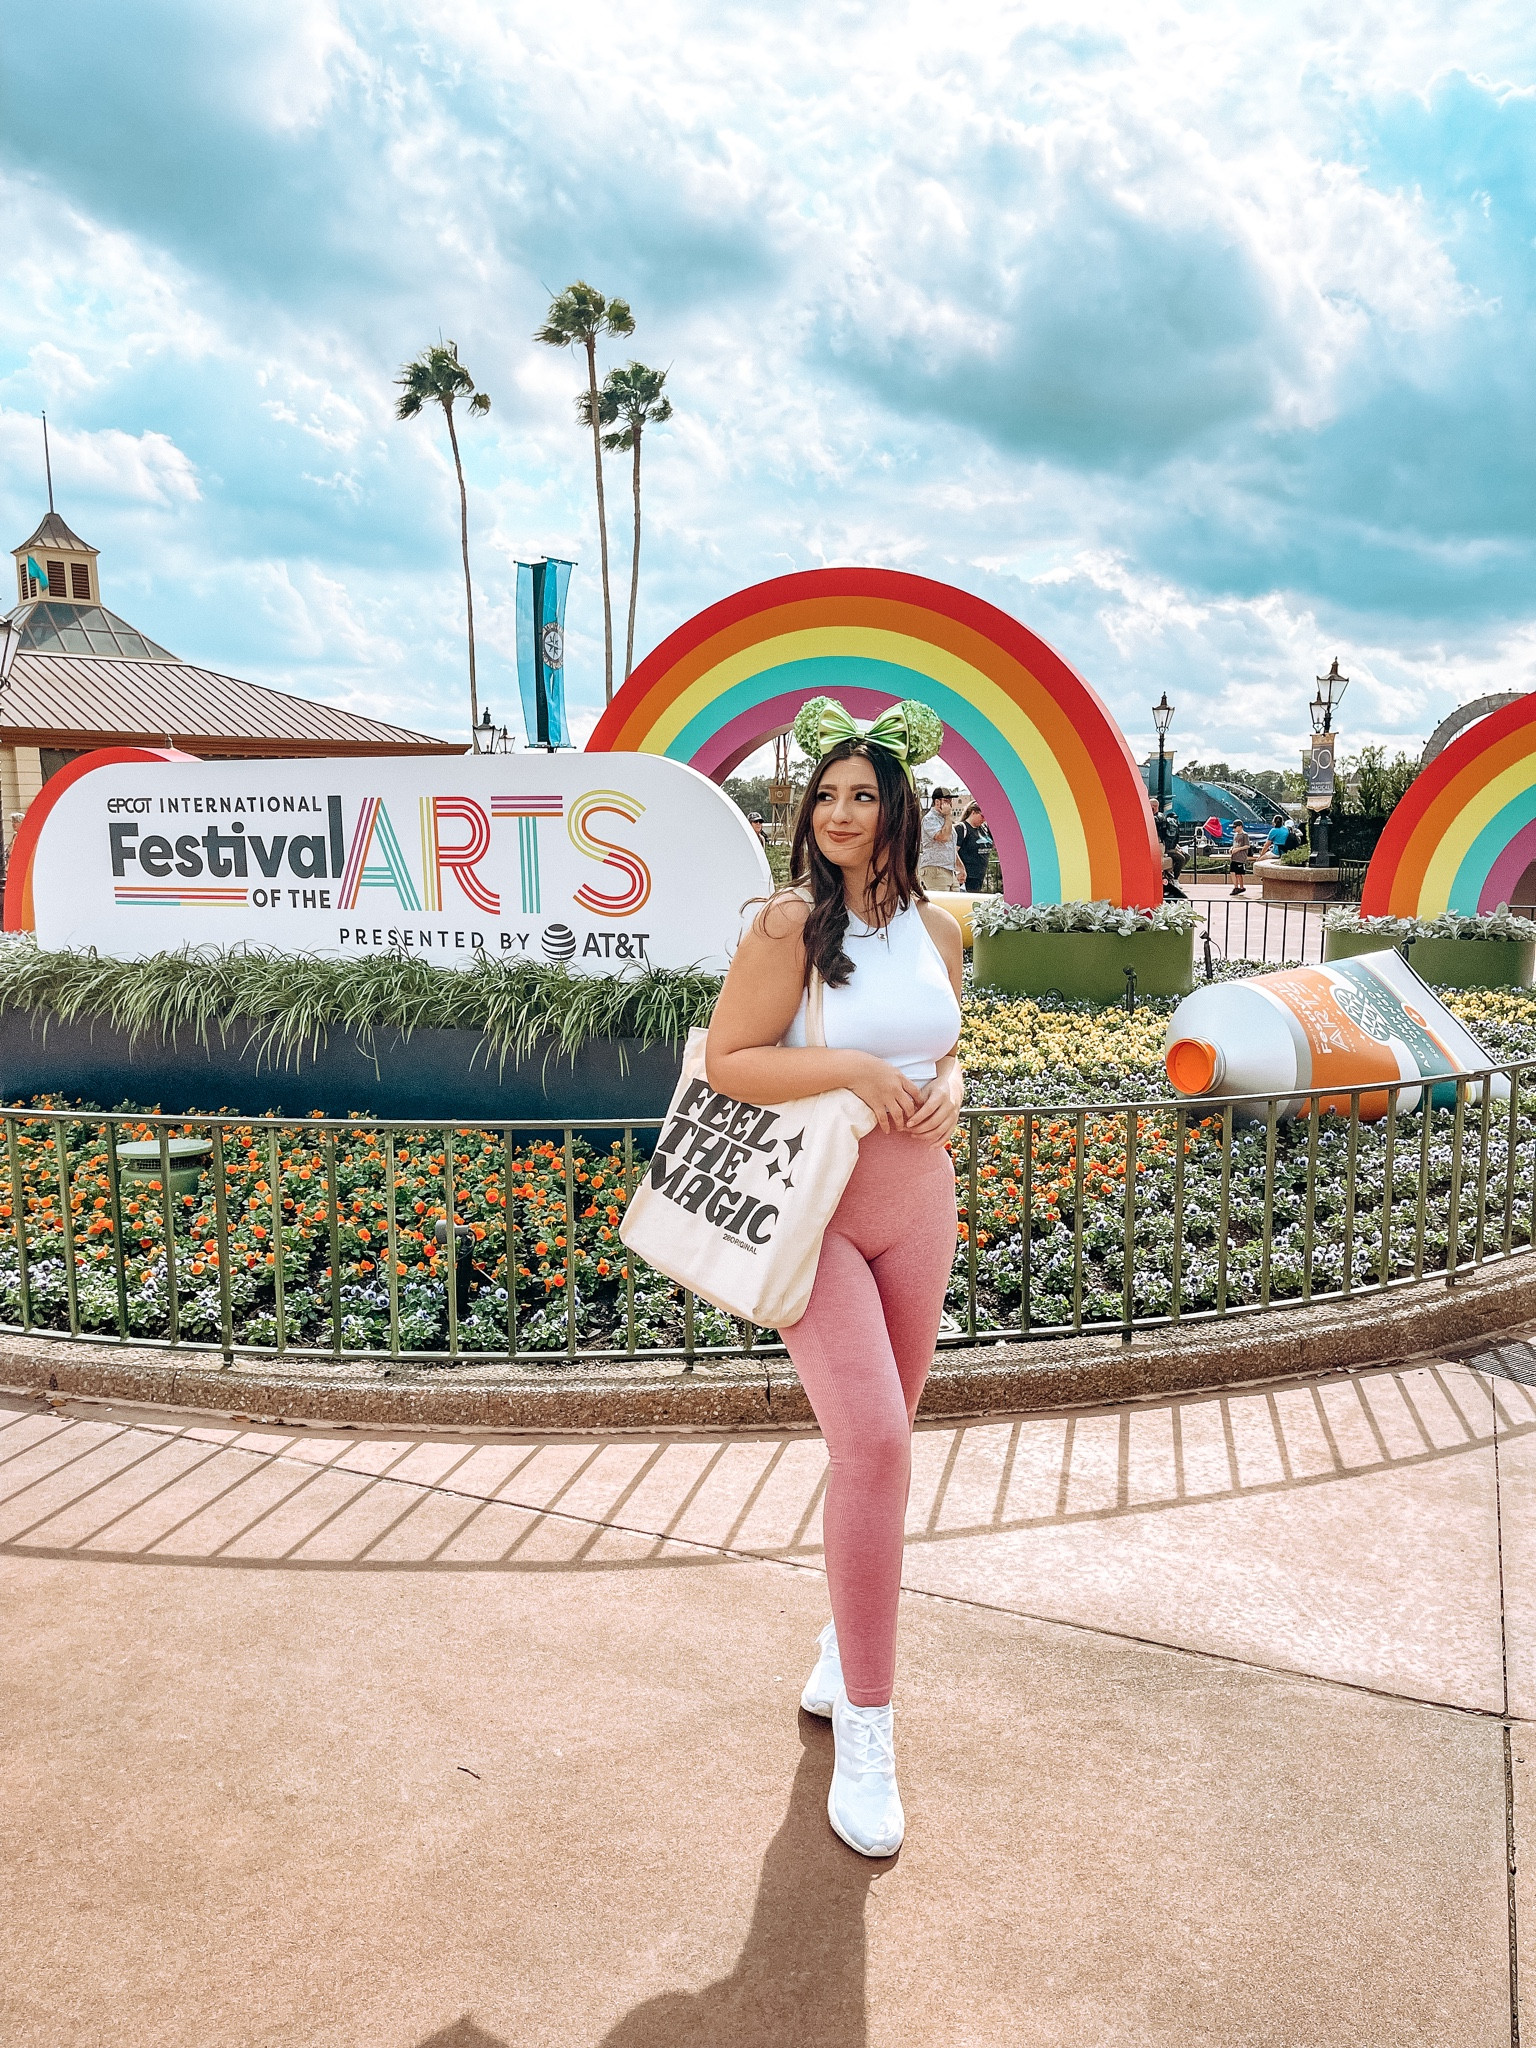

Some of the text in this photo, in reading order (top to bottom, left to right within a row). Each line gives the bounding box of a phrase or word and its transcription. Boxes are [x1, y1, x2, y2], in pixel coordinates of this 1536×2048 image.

[1312, 748, 1332, 780] 50
[107, 796, 322, 814] EPCOT INTERNATIONAL
[108, 795, 345, 879] Festival
[337, 789, 652, 918] ARTS
[253, 888, 331, 909] OF THE
[339, 927, 650, 959] PRESENTED BY AT&T
[1279, 989, 1333, 1054] Festival
[1284, 981, 1351, 1053] ARTS
[1343, 970, 1431, 1068] AUTUMN FLOWER
[1374, 992, 1417, 1040] ORANGE
[657, 1115, 753, 1185] THE
[675, 1077, 781, 1153] FEEL
[646, 1151, 780, 1245] MAGIC
